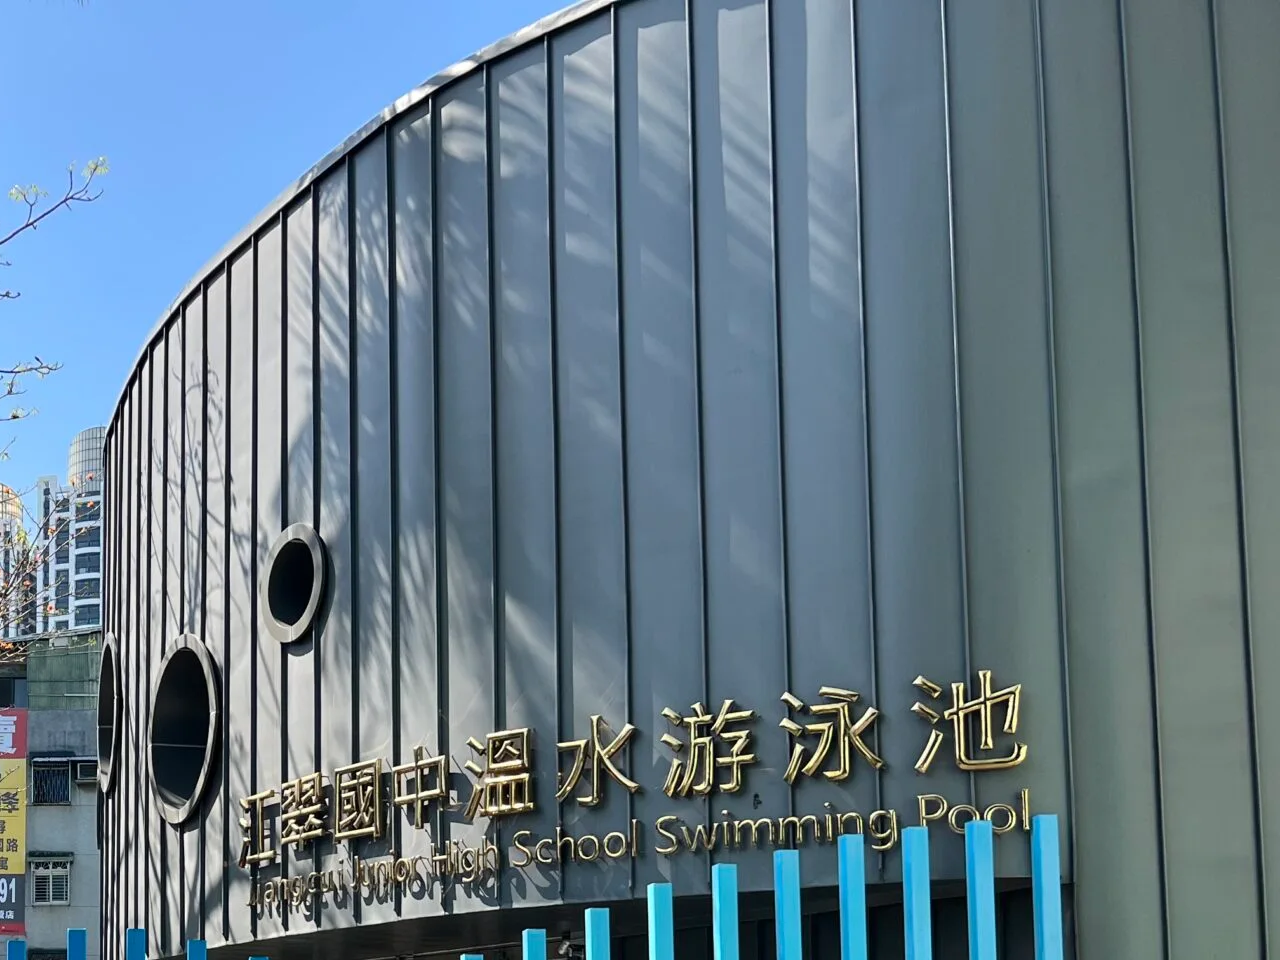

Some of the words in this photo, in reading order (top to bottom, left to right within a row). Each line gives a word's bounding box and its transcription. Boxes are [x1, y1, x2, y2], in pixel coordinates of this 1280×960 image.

[350, 848, 420, 888] Junior
[430, 835, 500, 883] High
[512, 818, 639, 867] School
[655, 801, 898, 855] Swimming
[918, 788, 1031, 836] Pool
